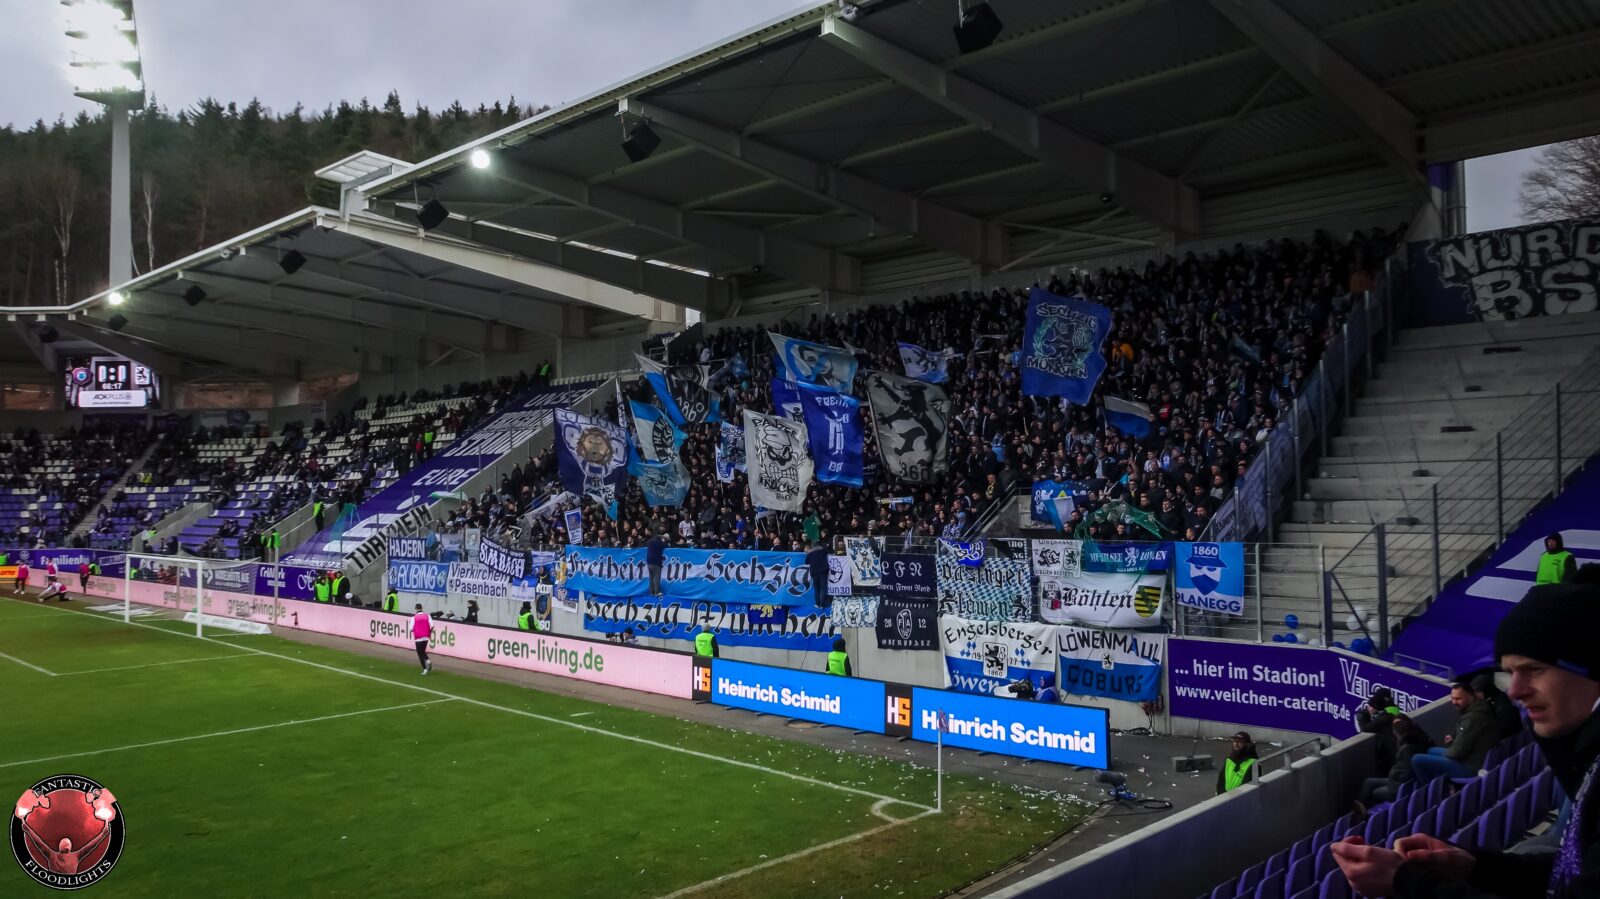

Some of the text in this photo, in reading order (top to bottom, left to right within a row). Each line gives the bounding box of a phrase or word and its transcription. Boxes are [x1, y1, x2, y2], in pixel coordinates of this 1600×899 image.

[414, 468, 479, 486] EURE
[389, 538, 426, 558] HADERN
[479, 543, 526, 579] SIMBACH
[1192, 545, 1219, 557] 1860
[397, 564, 438, 590] AUBING
[451, 562, 508, 582] Vierkirchen
[661, 555, 692, 583] ür
[703, 552, 812, 598] Sechzig
[455, 579, 508, 598] Pasenbach
[1062, 586, 1133, 613] Böhlen
[1176, 591, 1241, 613] PLANEGG
[370, 619, 456, 649] green-lig.de
[944, 620, 1054, 656] Engelsberger
[487, 637, 605, 674] green-living.de
[952, 669, 1000, 694] öwen
[987, 669, 1003, 677] 1860
[1193, 659, 1223, 678] hier
[1228, 661, 1248, 680] im
[1252, 664, 1326, 688] Stadion!
[694, 666, 841, 715] HS Heinrich Schmid
[1175, 684, 1351, 721] www.veilchen-catering.de
[887, 696, 911, 727] HS
[1010, 721, 1096, 754] Schmid
